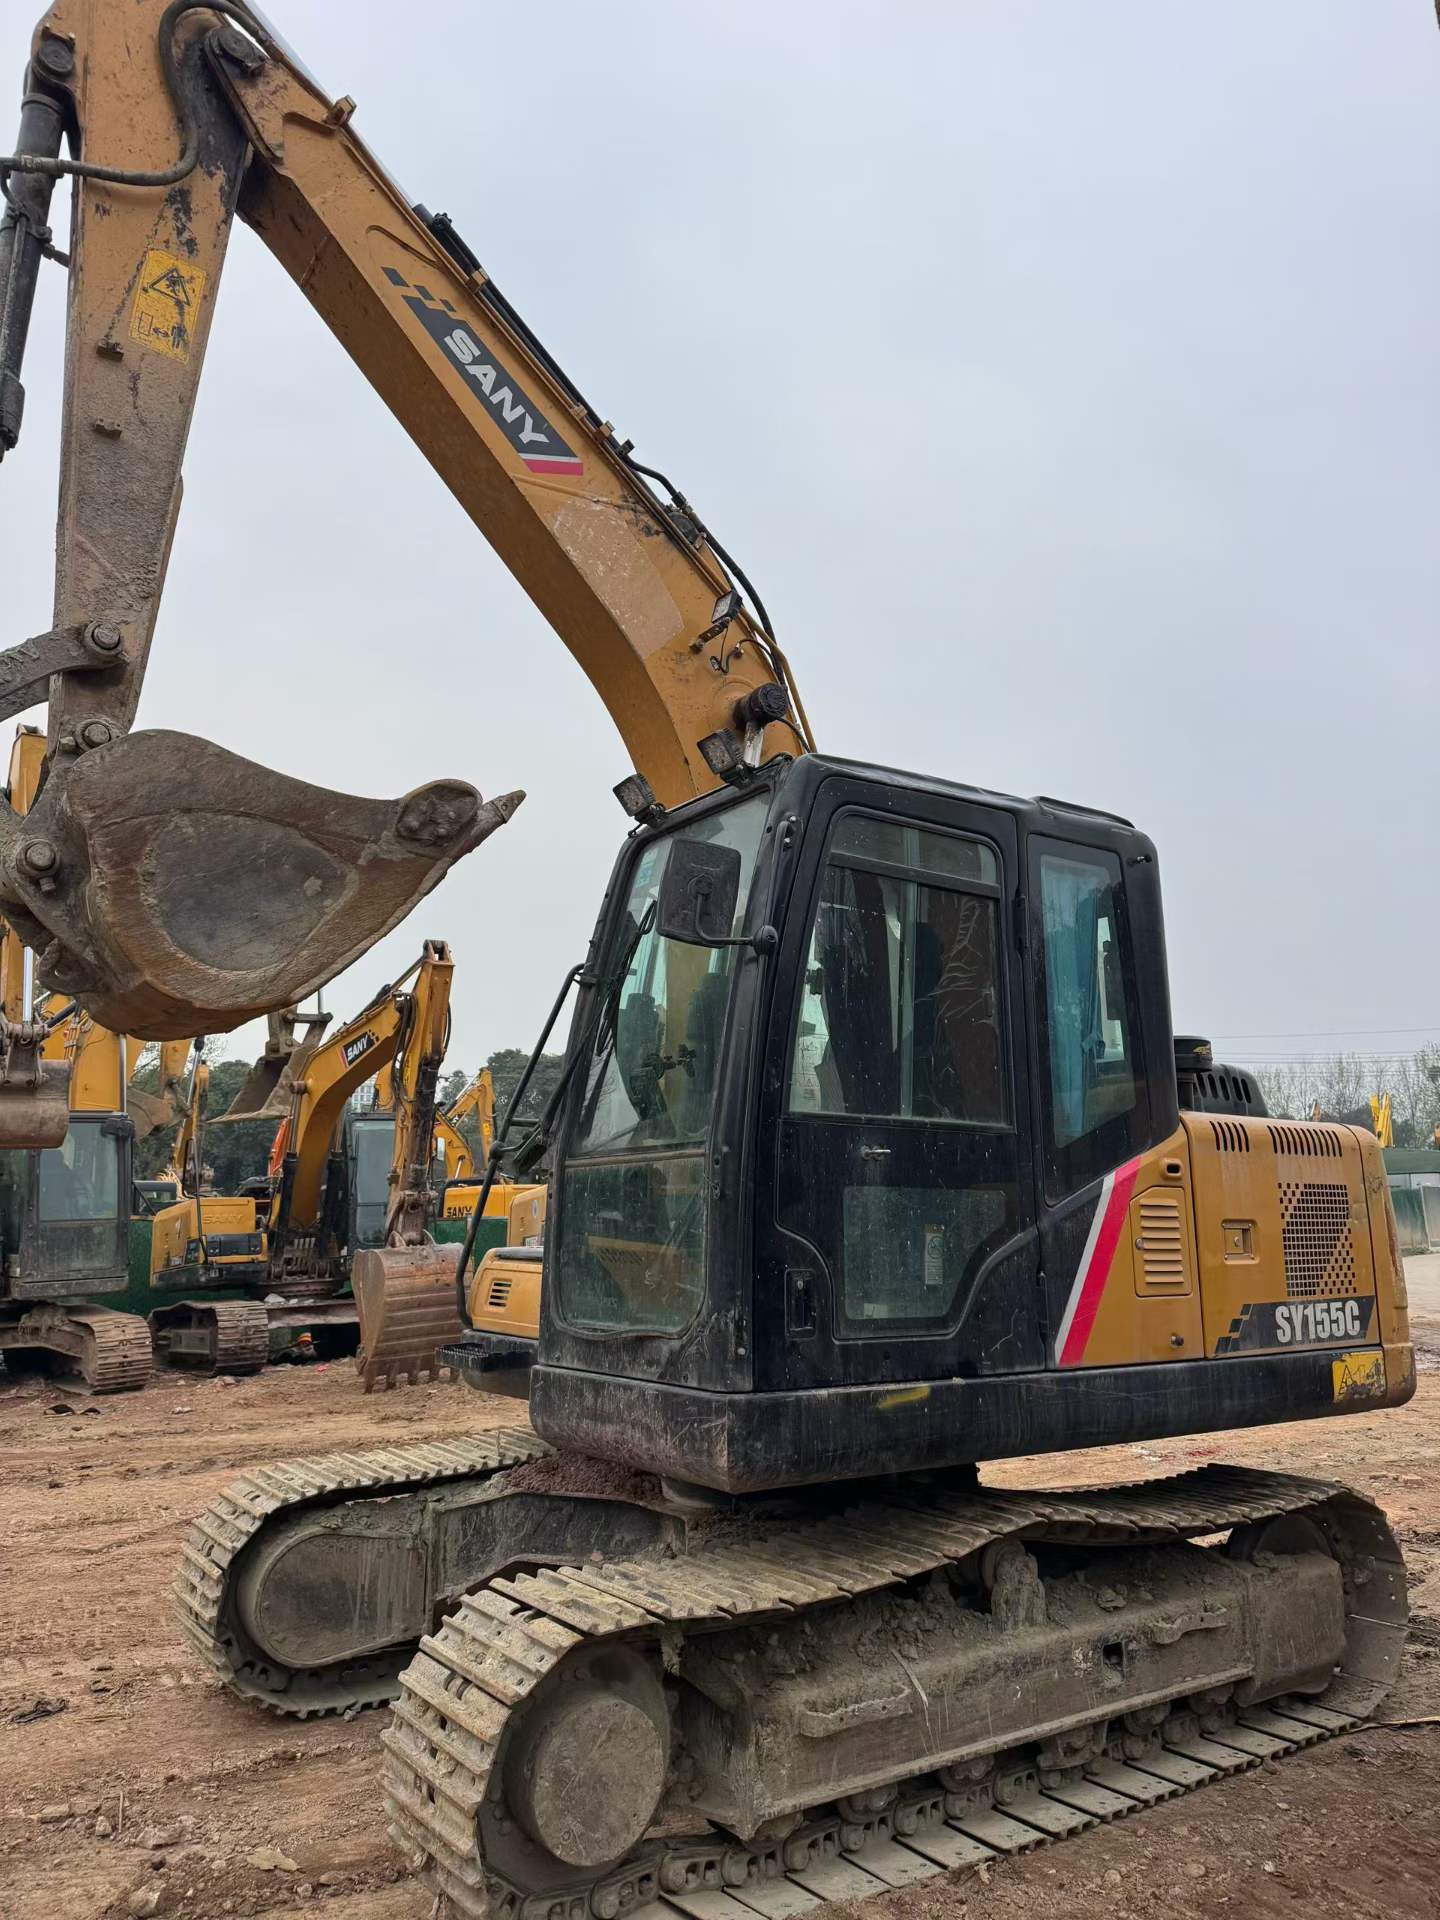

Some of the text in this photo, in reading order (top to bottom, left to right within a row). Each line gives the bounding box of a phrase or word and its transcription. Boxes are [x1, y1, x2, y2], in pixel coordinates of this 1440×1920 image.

[444, 328, 549, 444] SANY
[347, 1034, 368, 1061] SANY
[1275, 1301, 1360, 1343] SY155C
